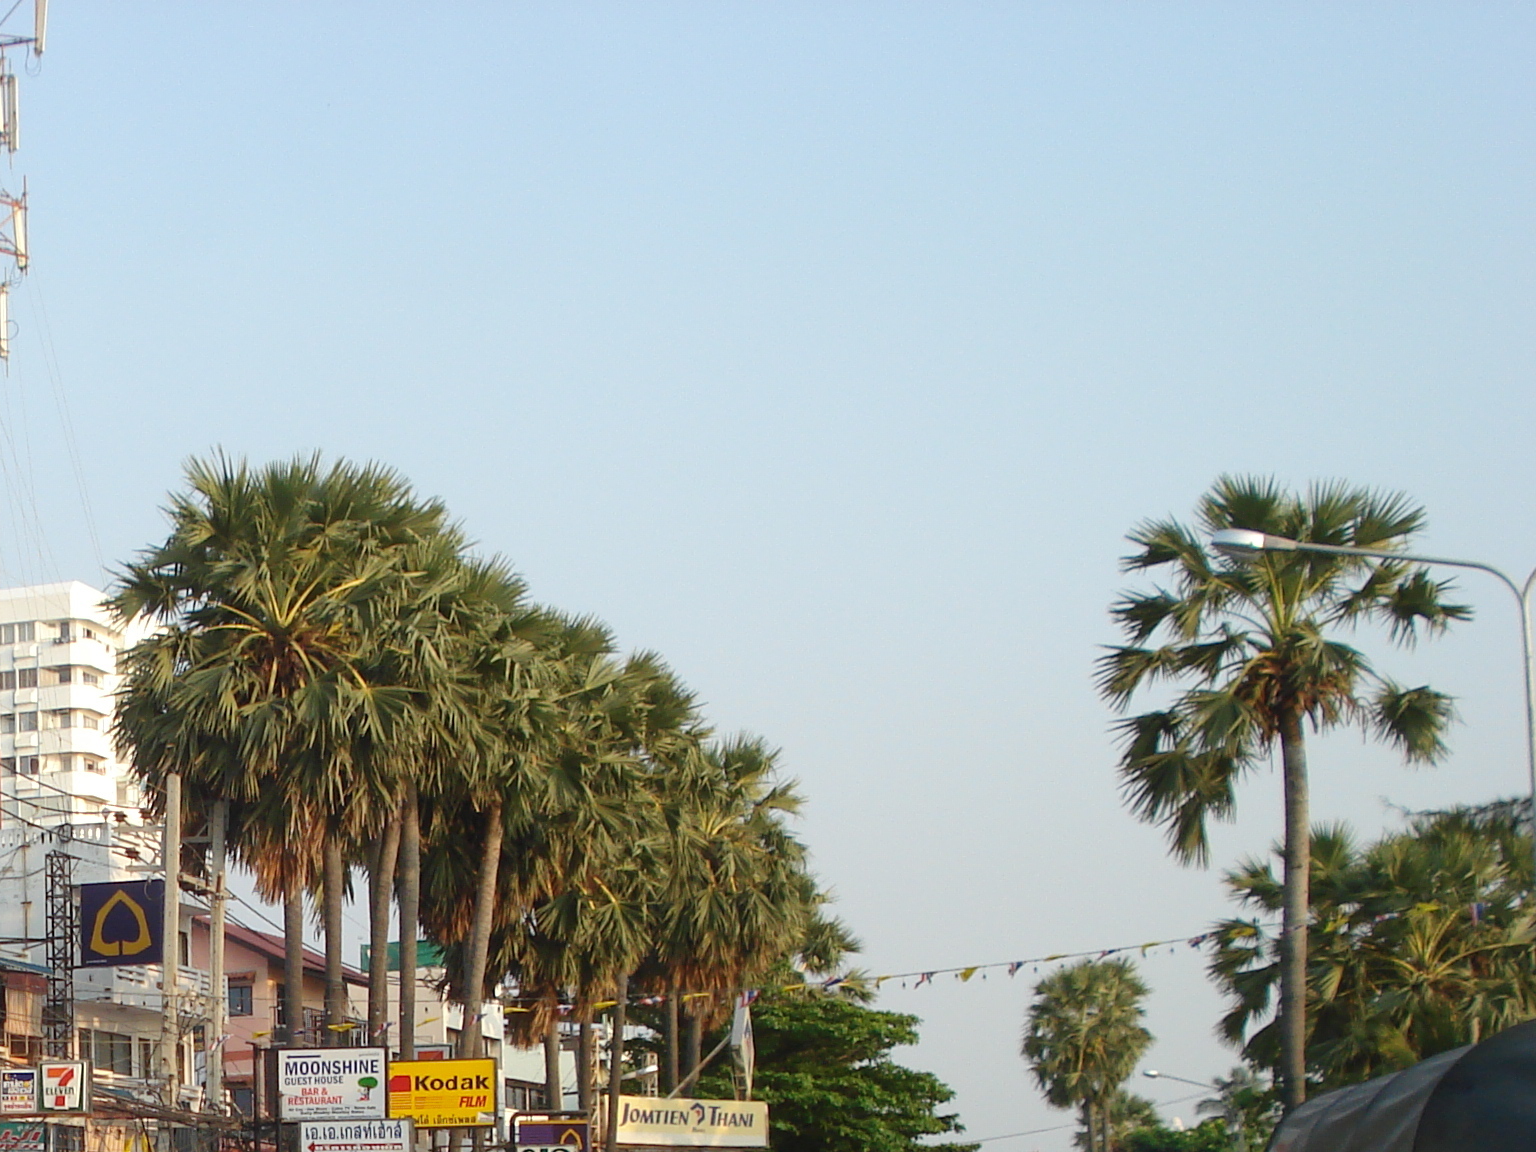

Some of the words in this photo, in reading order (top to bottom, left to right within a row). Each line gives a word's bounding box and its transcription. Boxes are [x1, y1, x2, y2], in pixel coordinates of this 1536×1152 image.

[284, 1059, 379, 1076] MOONSHINE
[47, 1067, 74, 1106] 7
[284, 1076, 312, 1086] GUEST
[314, 1075, 344, 1085] HOUSE
[414, 1075, 490, 1091] Kodak
[301, 1087, 319, 1096] BAR
[321, 1087, 328, 1096] &
[287, 1095, 343, 1106] RESTAURANT
[459, 1095, 487, 1108] FILM
[619, 1102, 690, 1127] JOMTIEN
[708, 1105, 754, 1128] THANI
